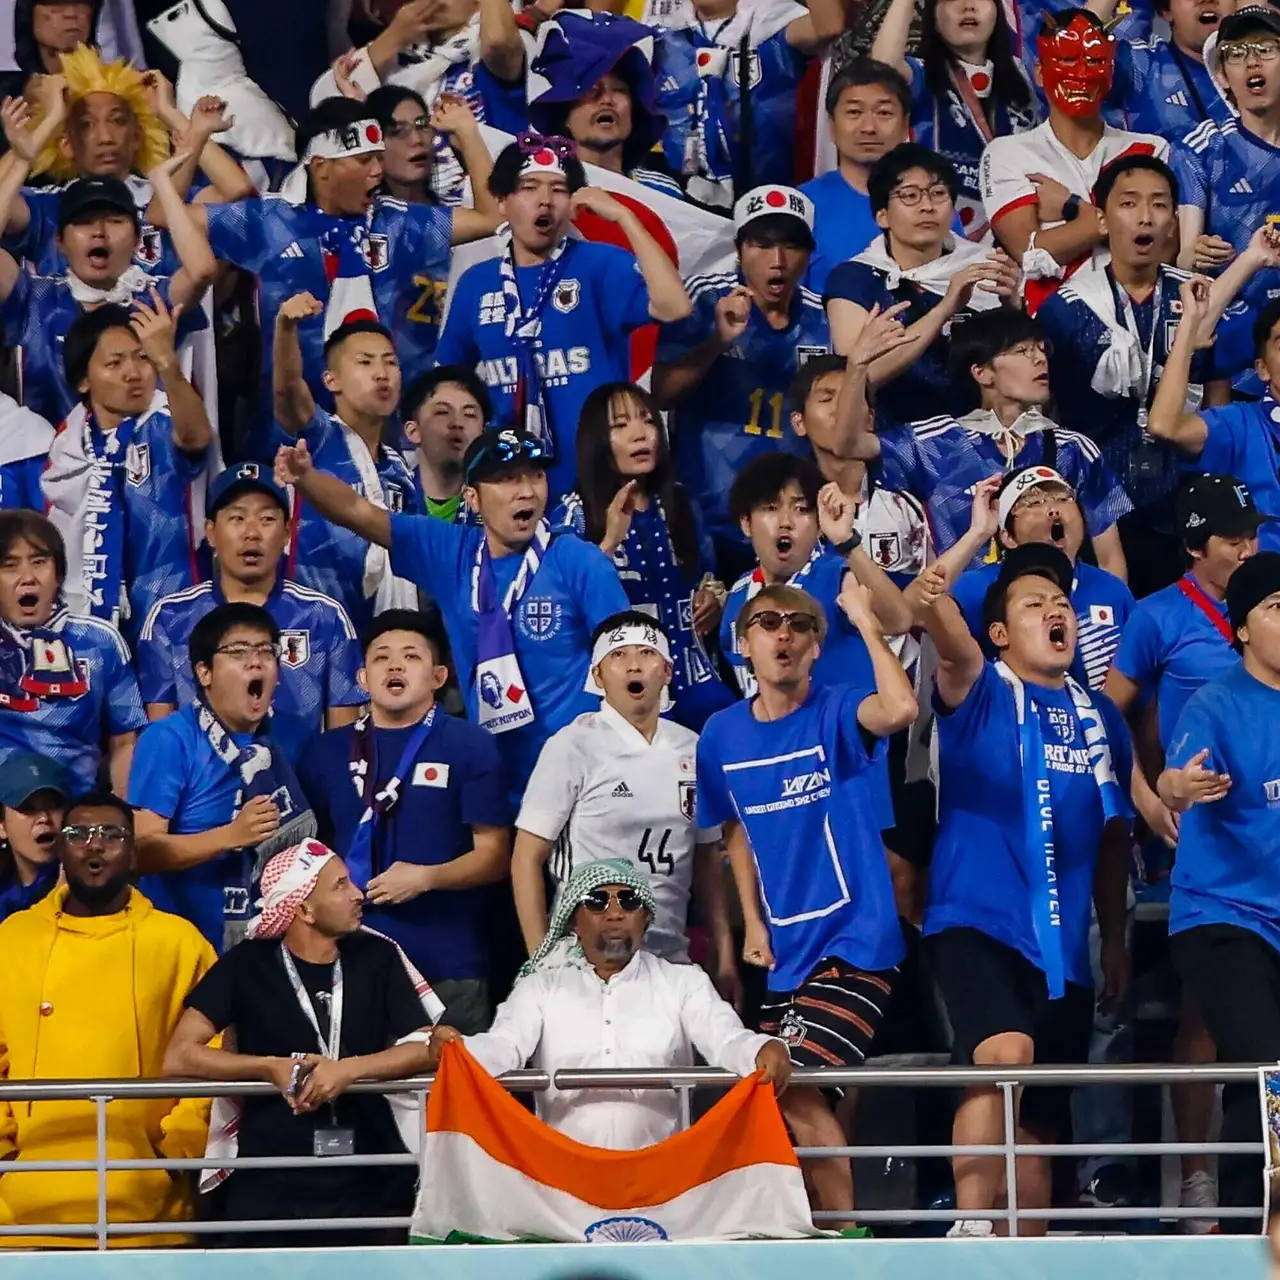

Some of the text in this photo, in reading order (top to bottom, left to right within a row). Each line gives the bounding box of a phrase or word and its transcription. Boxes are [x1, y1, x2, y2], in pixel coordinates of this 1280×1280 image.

[746, 194, 806, 218] 必勝
[743, 387, 784, 439] 11
[781, 767, 832, 799] JAPAN
[637, 827, 674, 876] 44
